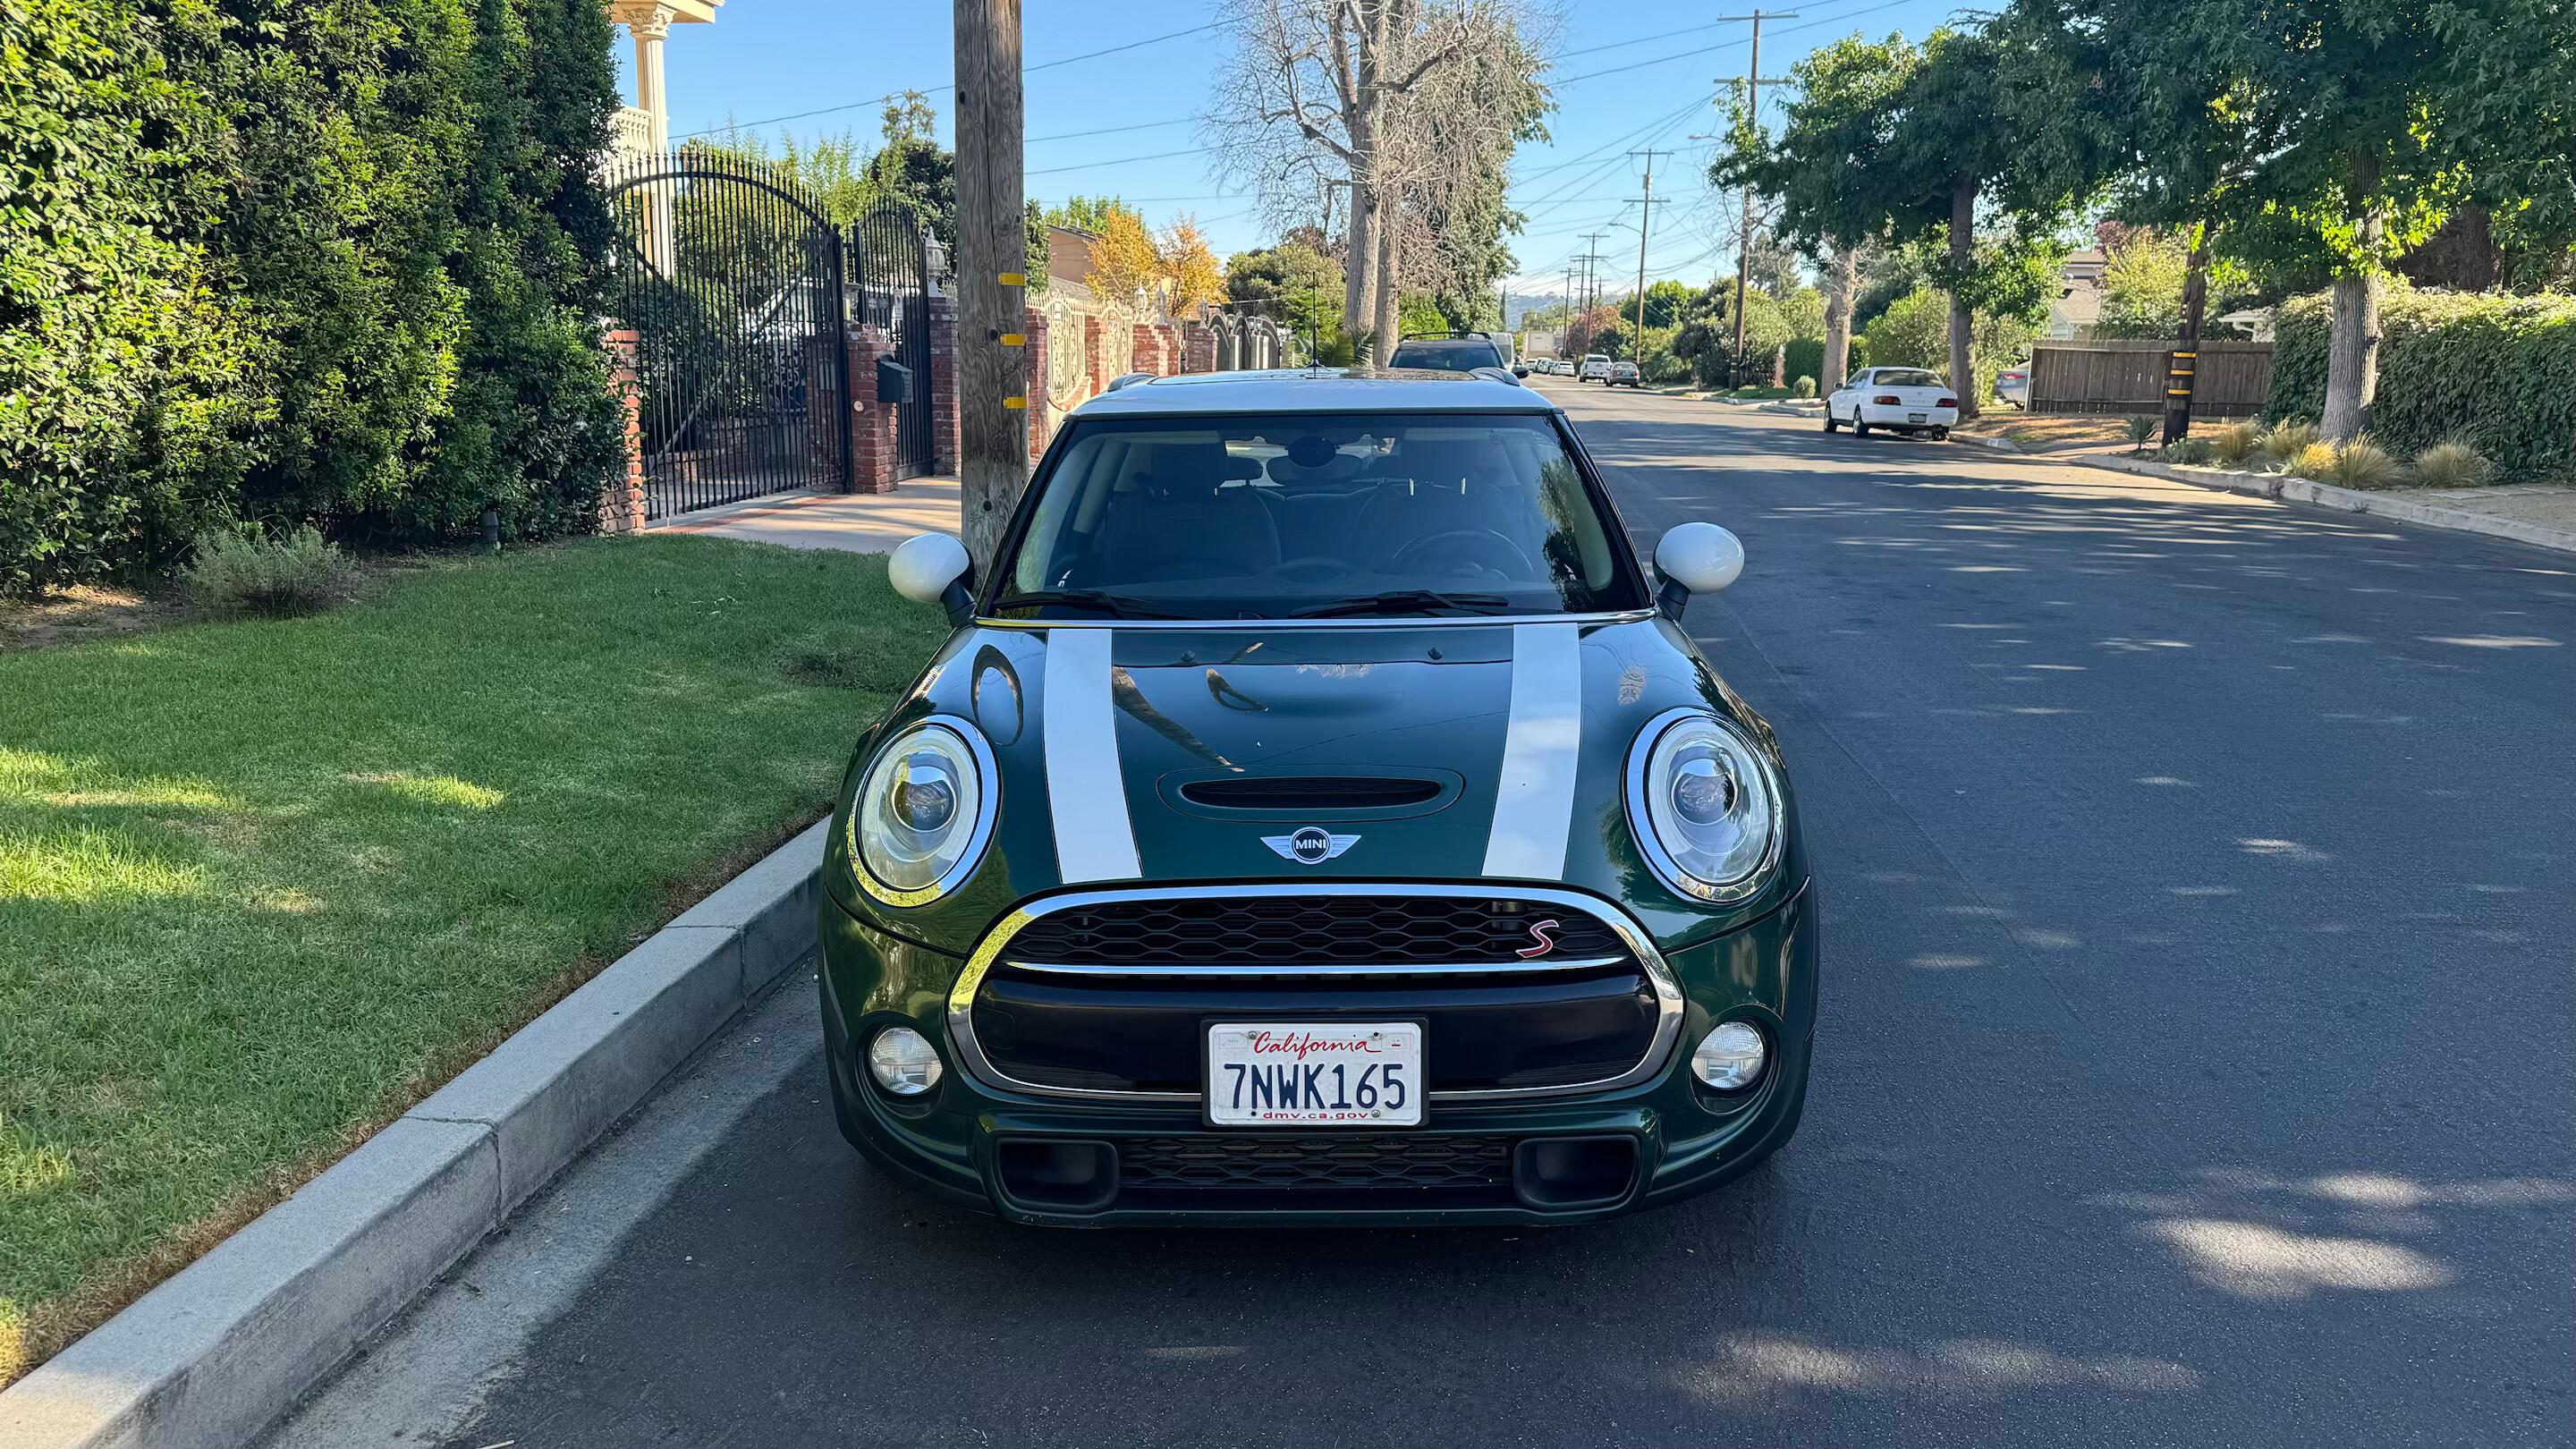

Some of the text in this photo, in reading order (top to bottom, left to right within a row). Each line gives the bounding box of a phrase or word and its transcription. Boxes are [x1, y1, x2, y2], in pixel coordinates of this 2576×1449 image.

[1295, 839, 1326, 849] MINI
[1515, 919, 1559, 958] S
[1254, 1031, 1382, 1060] California
[1224, 1063, 1405, 1109] 7NWK165
[1263, 1111, 1368, 1120] dmv.ca.gov
